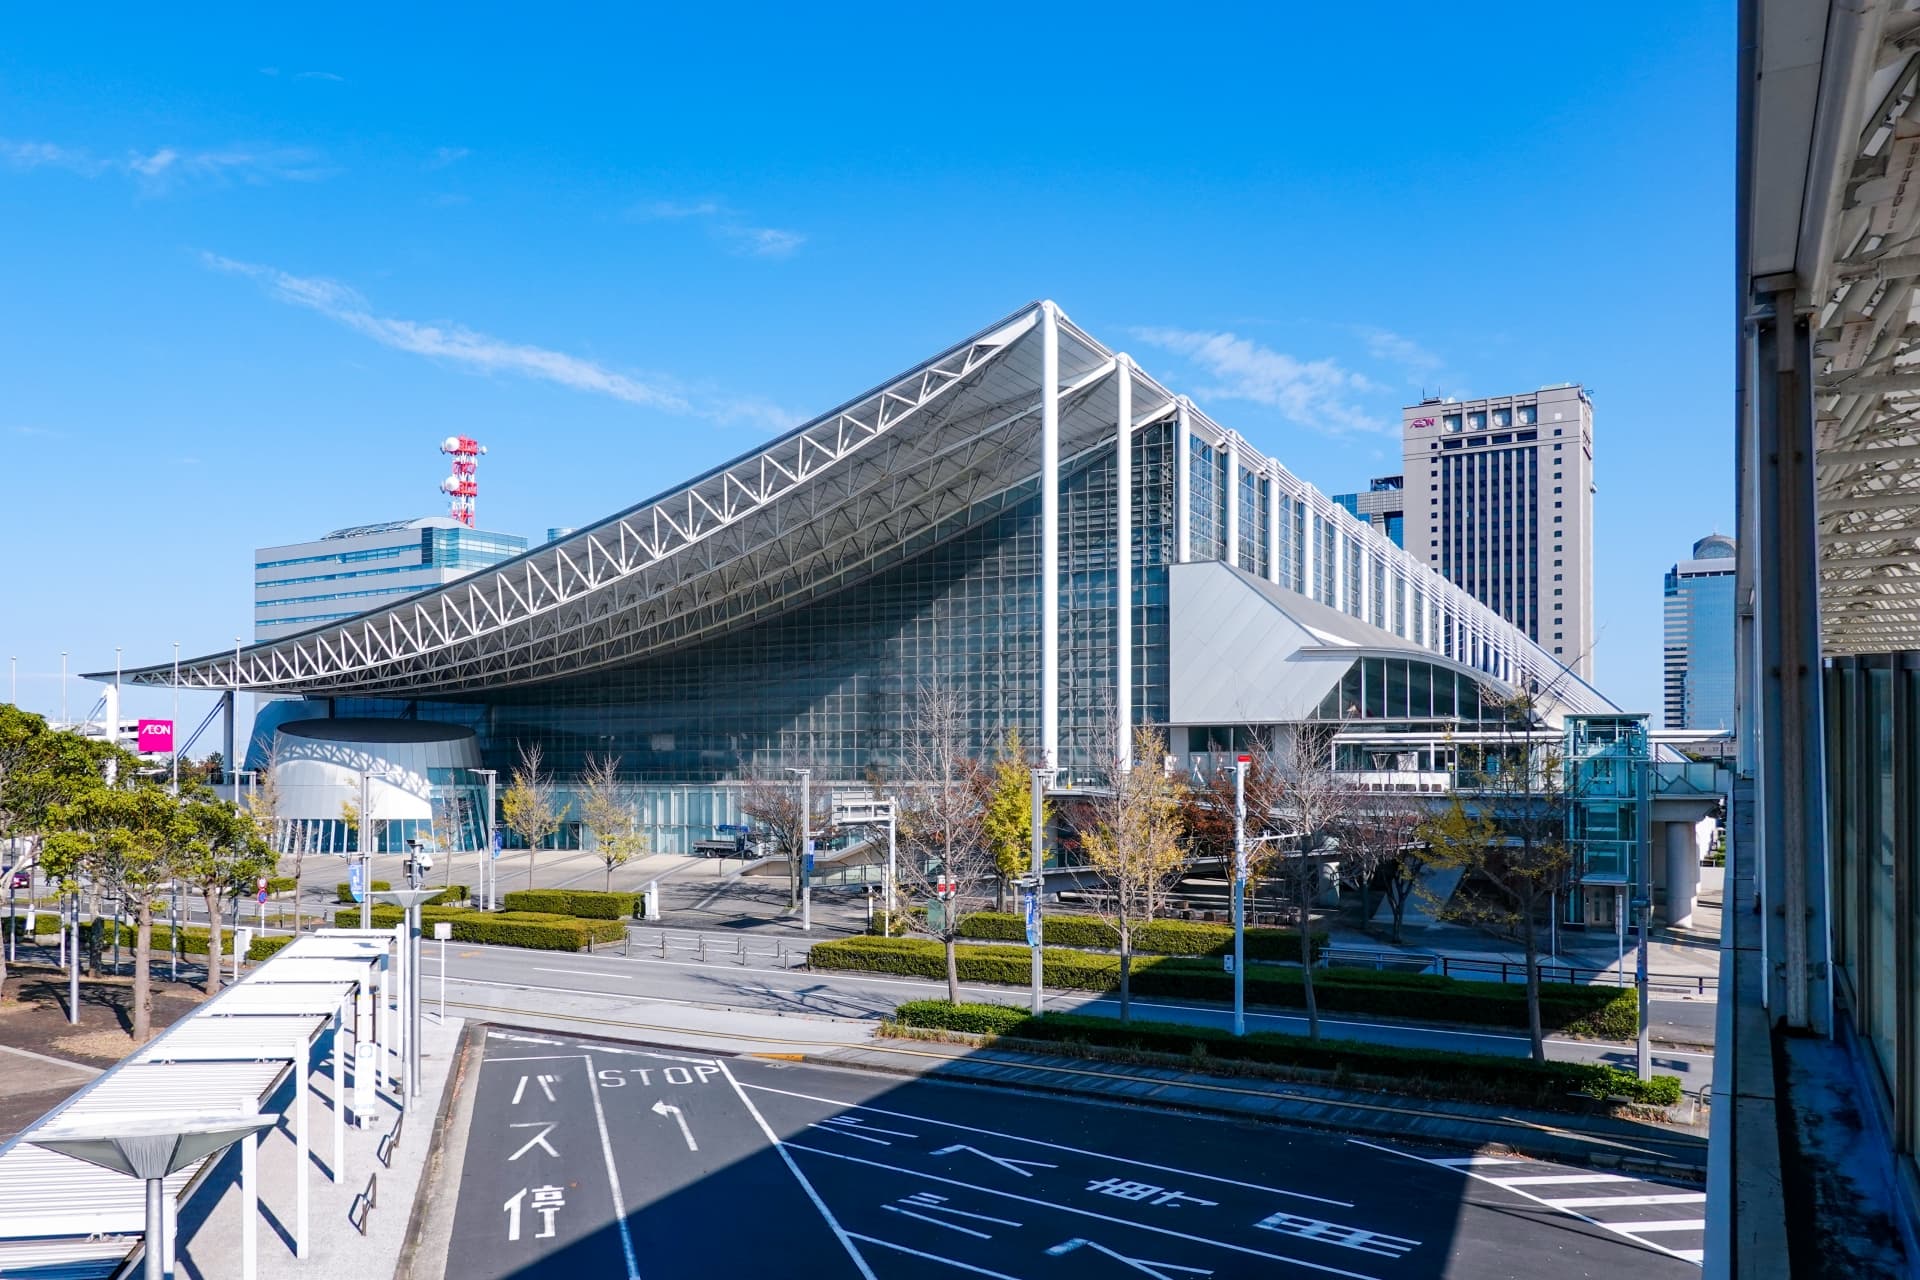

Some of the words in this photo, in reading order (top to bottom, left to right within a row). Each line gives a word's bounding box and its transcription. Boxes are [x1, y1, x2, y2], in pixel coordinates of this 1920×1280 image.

[598, 1066, 719, 1087] STOP
[504, 1075, 566, 1241] バス停
